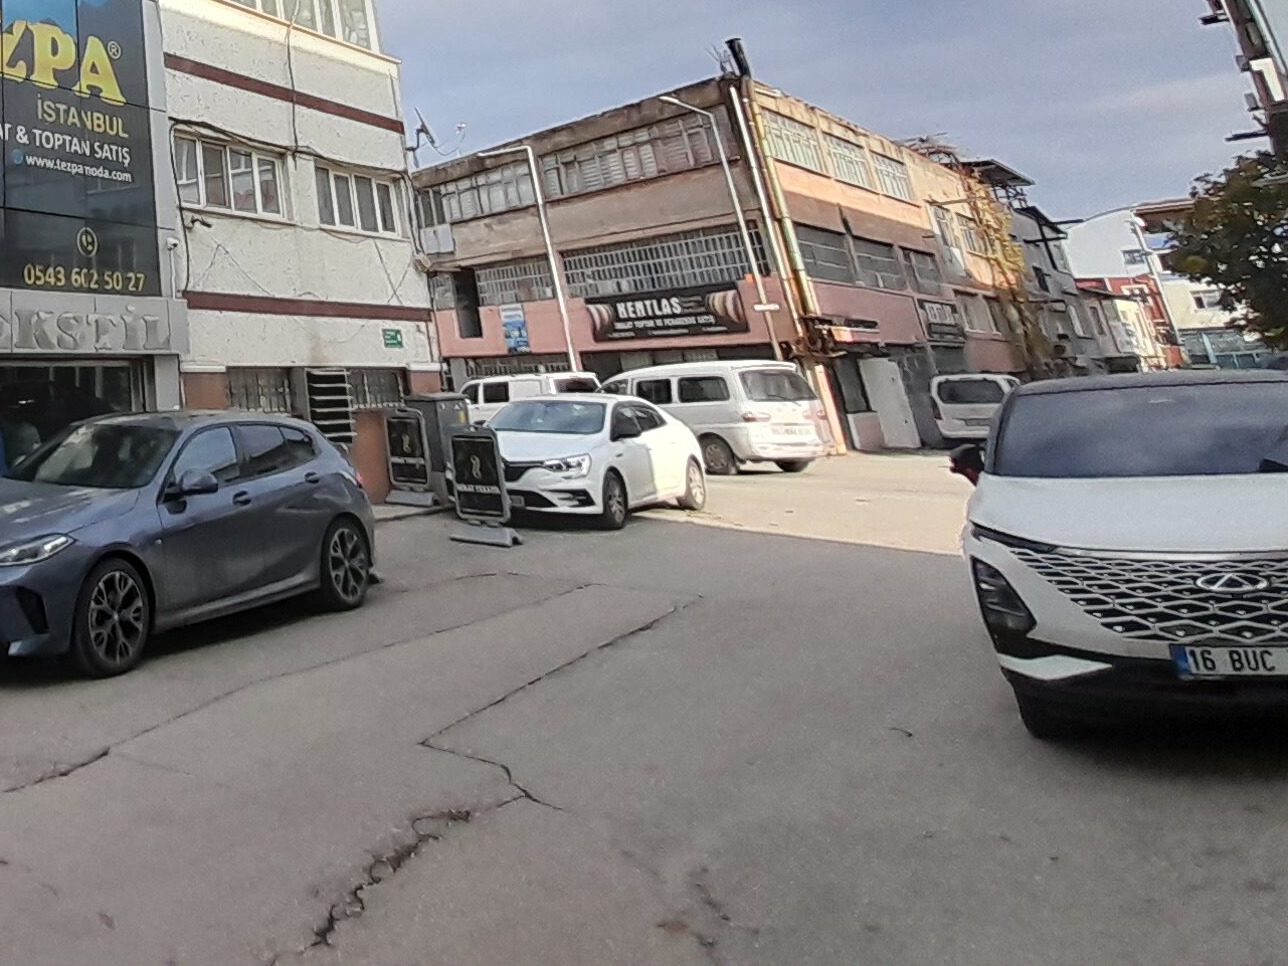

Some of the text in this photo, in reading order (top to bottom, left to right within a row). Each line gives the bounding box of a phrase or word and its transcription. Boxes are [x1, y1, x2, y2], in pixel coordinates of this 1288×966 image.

[37, 93, 129, 138] İSTANBUL
[15, 125, 30, 145] &
[32, 129, 90, 156] TOPTAN
[94, 142, 131, 167] SATIŞ
[24, 263, 66, 287] 0543
[104, 271, 123, 291] 50
[126, 272, 145, 292] 27
[1189, 649, 1275, 672] 16 BUC
